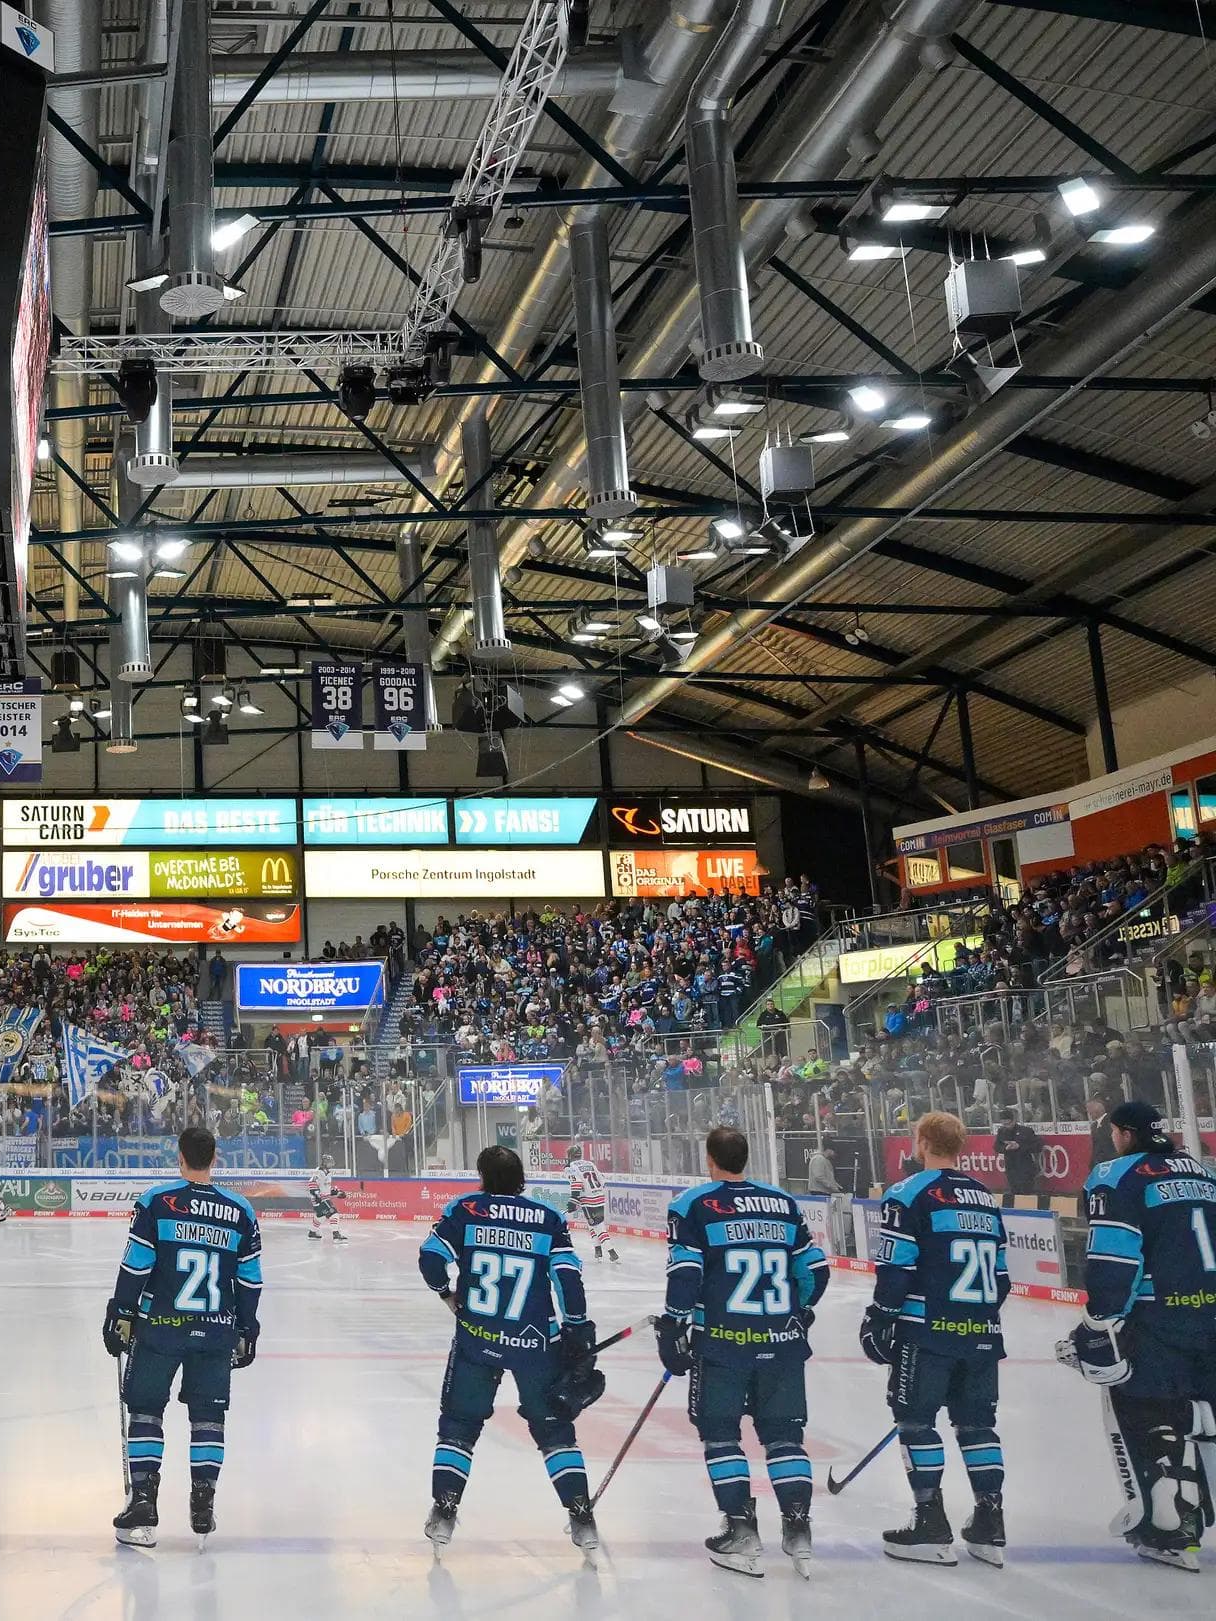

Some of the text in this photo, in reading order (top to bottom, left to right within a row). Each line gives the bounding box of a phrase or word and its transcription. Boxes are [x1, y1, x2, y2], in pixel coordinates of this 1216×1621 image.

[320, 676, 354, 686] FICENEC
[379, 678, 417, 687] GOODALL
[322, 686, 353, 710] 38
[383, 687, 414, 711] 96
[21, 805, 85, 822] SATURN
[164, 809, 281, 834] DAS BESTE
[307, 803, 560, 833] FÜR TECHNIK FANS!
[661, 808, 750, 833] SATURN
[39, 824, 84, 840] CARD
[983, 818, 1028, 835] Glasfaser
[154, 856, 240, 877] OVERTIME BEI
[371, 868, 536, 883] Porsche Zentrum Ingolstadt
[636, 868, 656, 877] DAS
[706, 857, 744, 878] LIVE
[38, 860, 134, 897] gruber
[636, 877, 684, 886] ORIGINAL
[111, 908, 164, 918] IT-Helden für
[14, 928, 60, 937] SysTec
[147, 920, 204, 929] Unternehmen
[259, 977, 361, 997] NORDBRÄU
[286, 998, 336, 1006] INGOLSTADT
[497, 1126, 517, 1137] WC
[190, 1198, 241, 1224] SATURN
[489, 1204, 545, 1224] SATURN
[733, 1196, 790, 1215] SATURN
[175, 1222, 230, 1249] SIMPSON
[475, 1227, 533, 1251] GIBBONS
[725, 1222, 787, 1242] EDWARDS
[174, 1248, 221, 1312] 21
[949, 1238, 998, 1304] 20
[467, 1250, 536, 1321] 37
[724, 1248, 792, 1316] 23
[710, 1324, 800, 1345] zieglerhaus
[1110, 1432, 1137, 1501] VAUGHN
